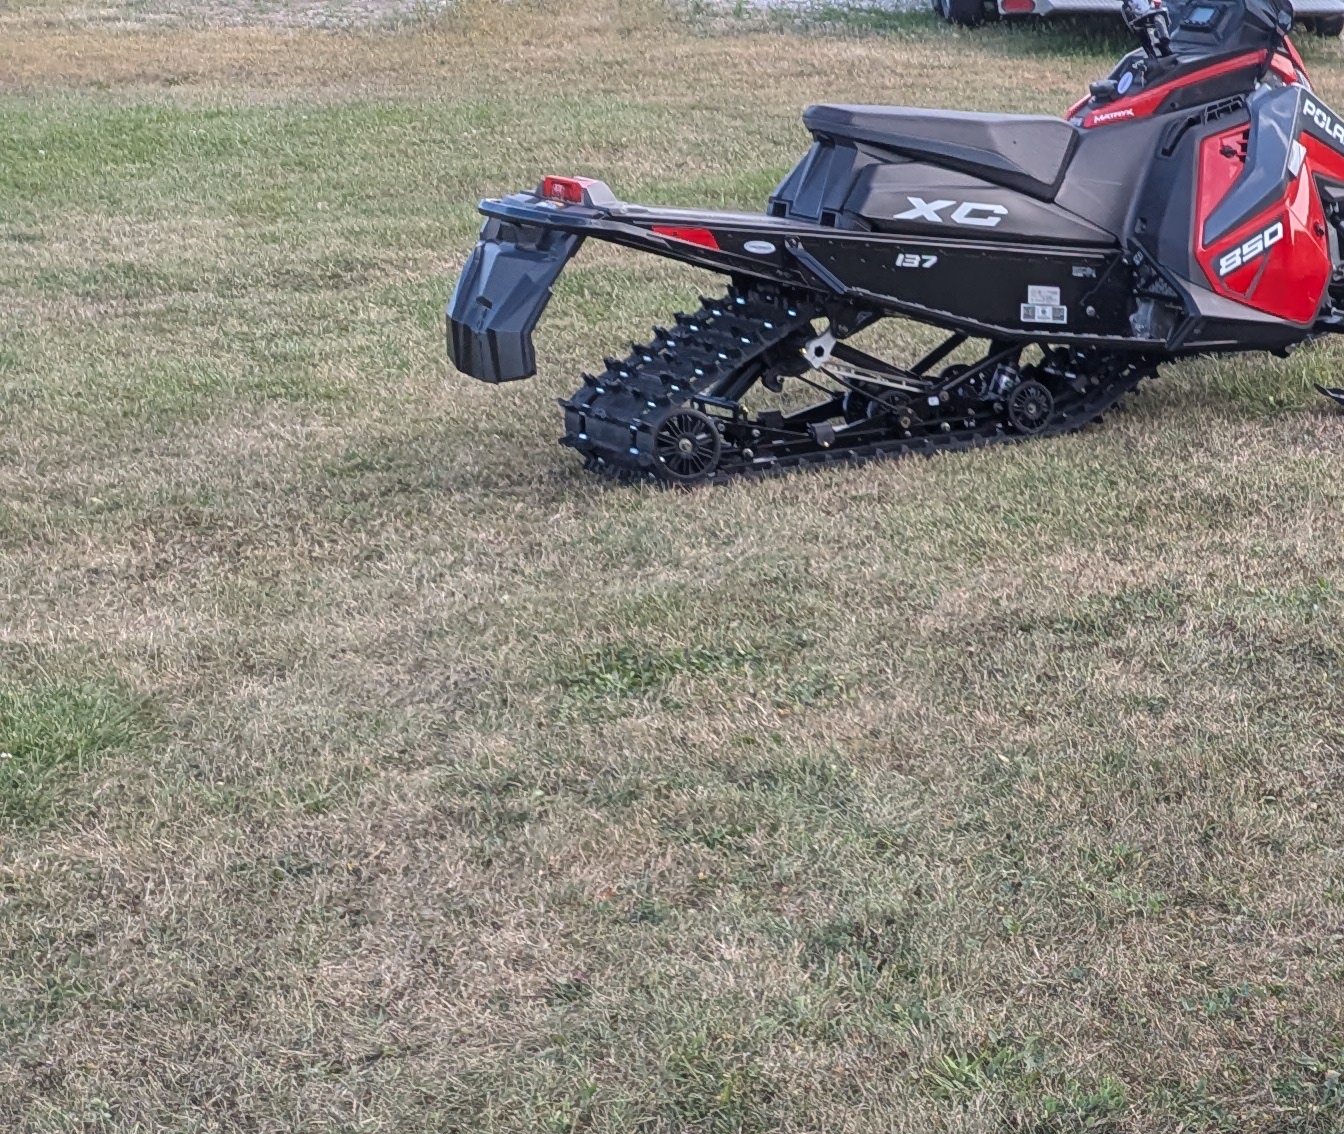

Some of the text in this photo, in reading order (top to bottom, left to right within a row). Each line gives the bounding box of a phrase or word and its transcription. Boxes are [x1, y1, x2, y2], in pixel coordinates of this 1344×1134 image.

[1093, 108, 1135, 124] MATRYX
[893, 196, 1009, 227] XC
[895, 252, 938, 268] 137
[1219, 221, 1284, 277] 850
